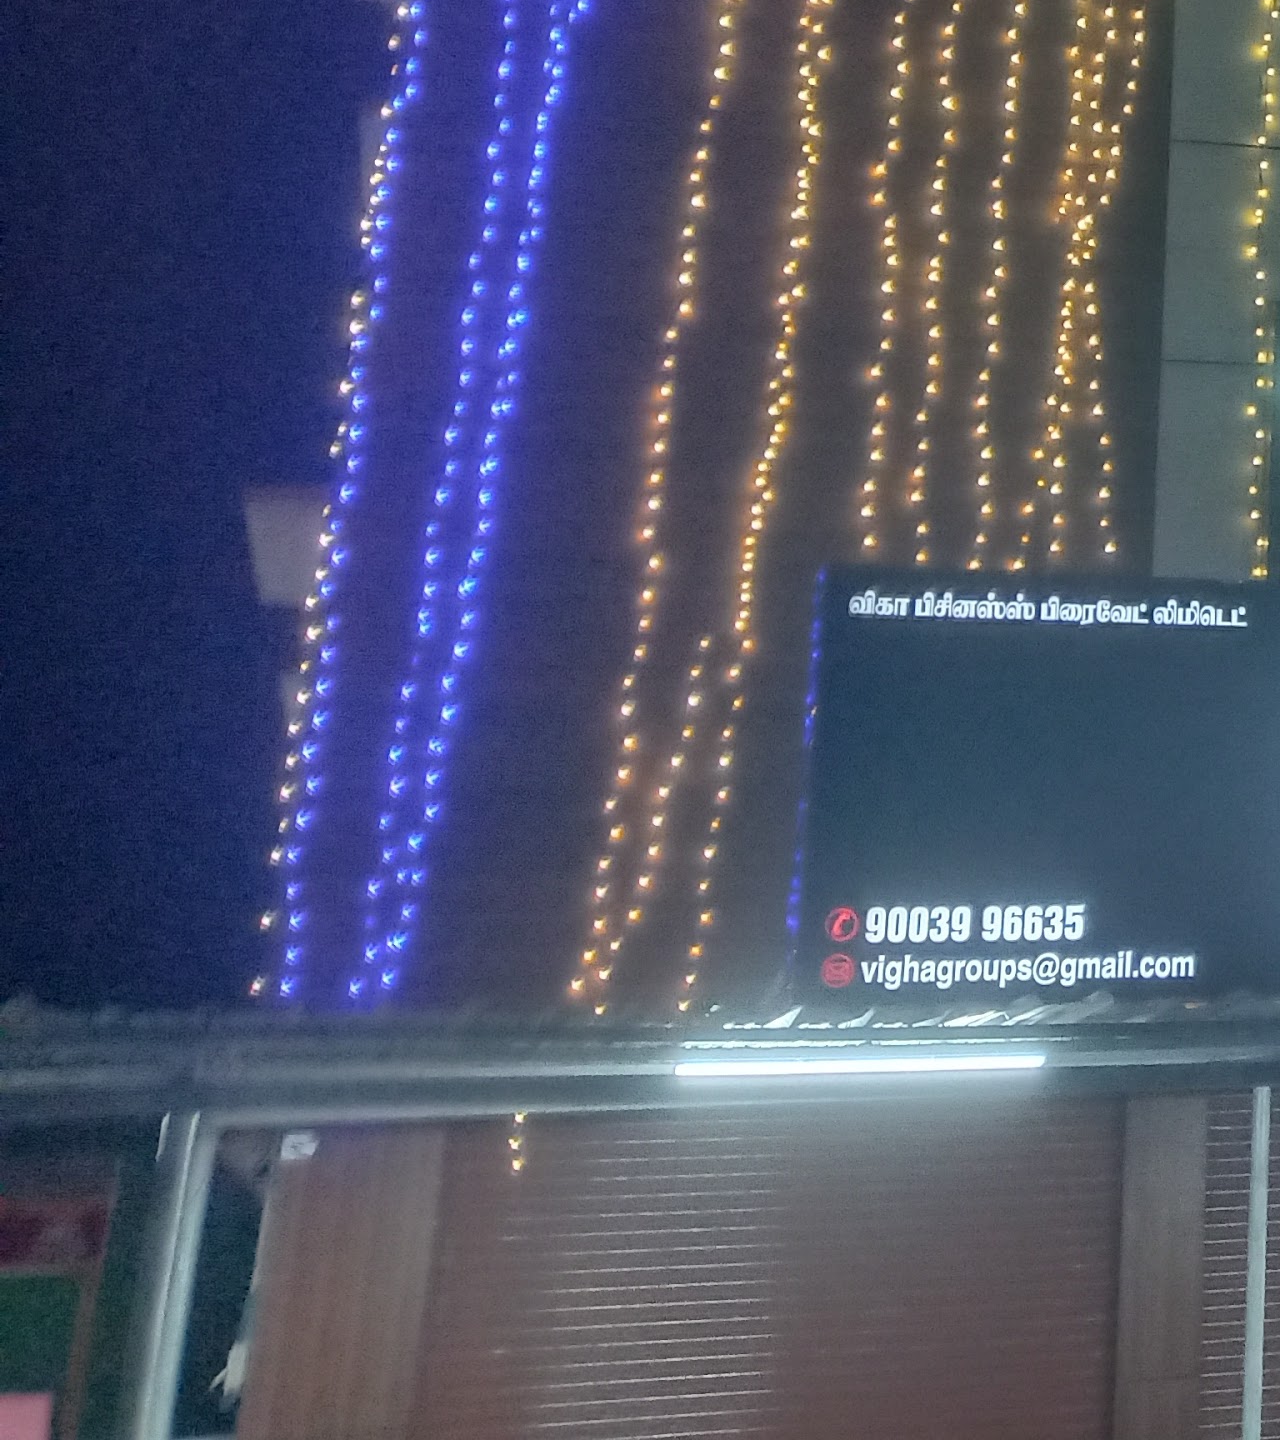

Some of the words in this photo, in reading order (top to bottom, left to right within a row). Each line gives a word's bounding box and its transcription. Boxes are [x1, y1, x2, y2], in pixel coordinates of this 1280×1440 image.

[849, 589, 910, 616] விகா
[914, 591, 1036, 620] பிசினஸ்ஸ்
[1040, 595, 1149, 625] பிரைவேட்
[1153, 599, 1248, 627] லிமிடெட்
[865, 906, 971, 943] 90039
[981, 903, 1086, 941] 96635
[860, 951, 1195, 990] vighagroups@gmail.com
